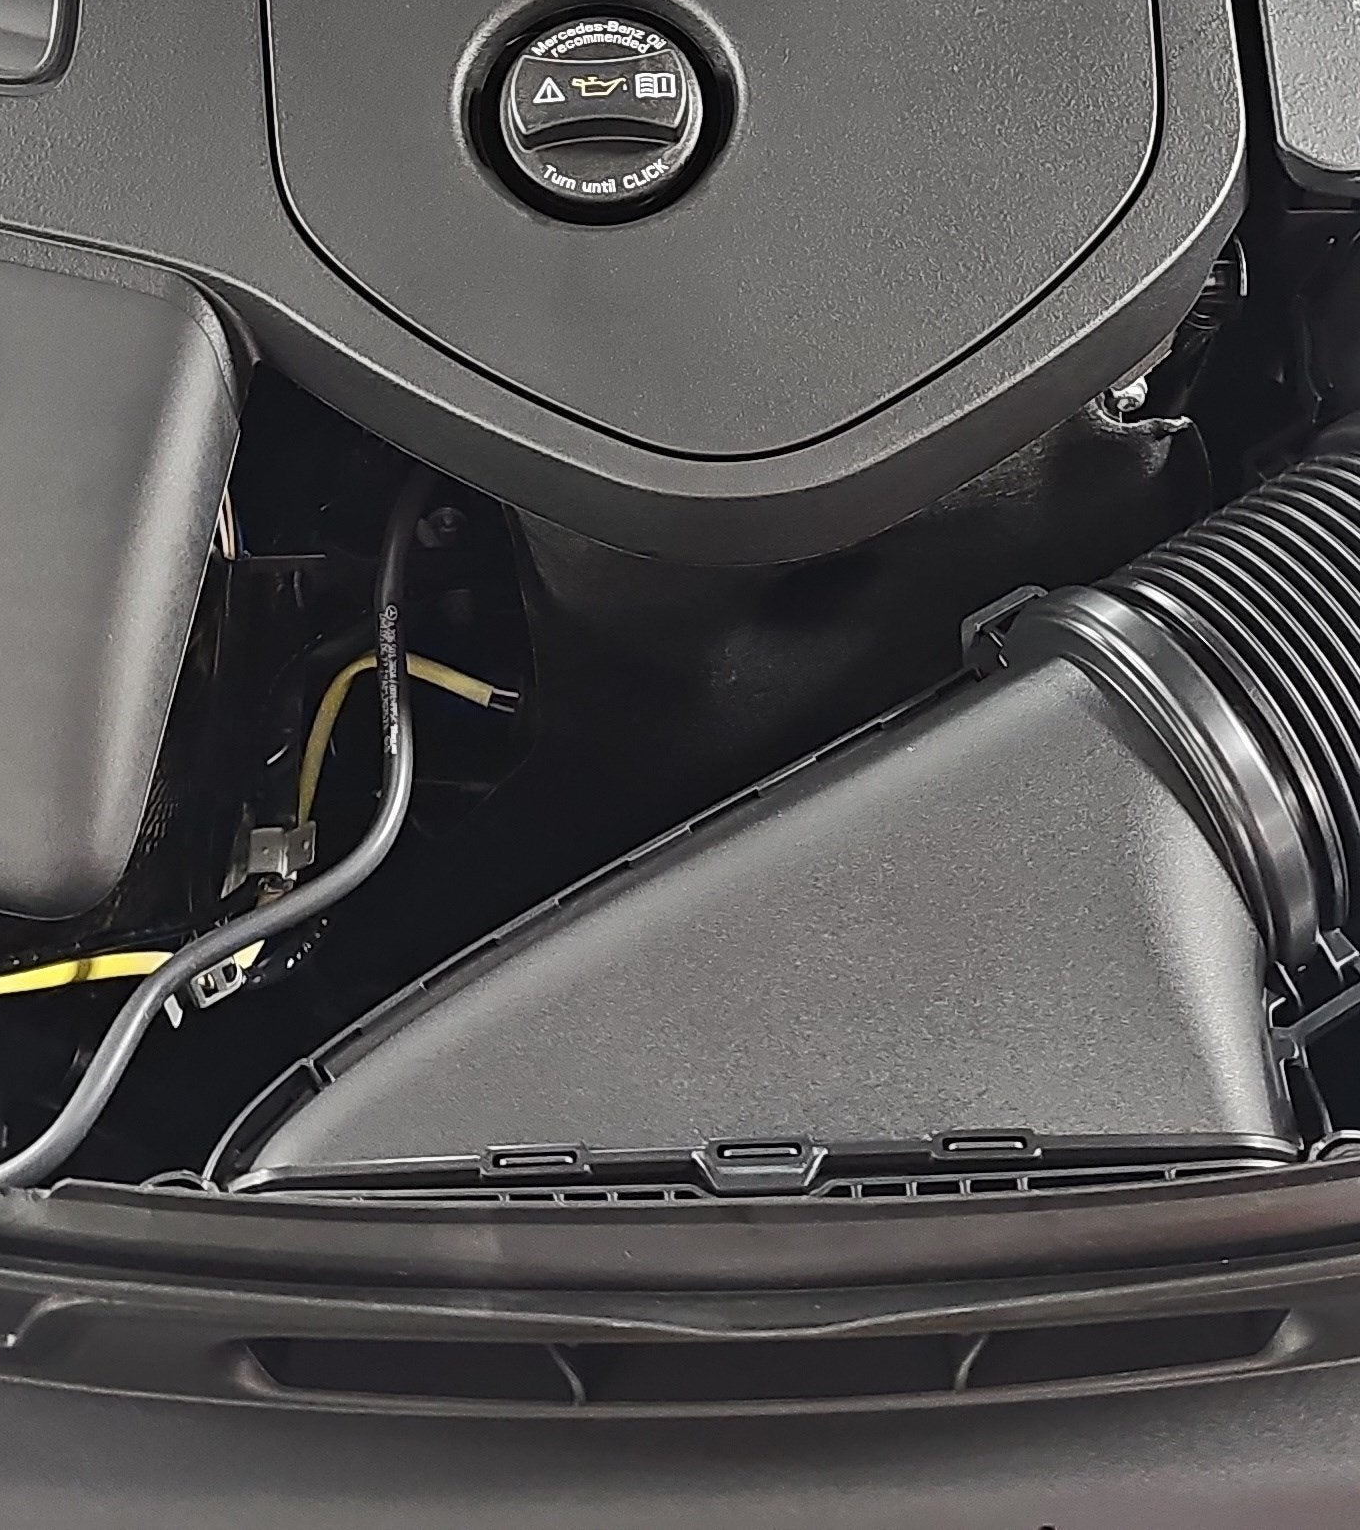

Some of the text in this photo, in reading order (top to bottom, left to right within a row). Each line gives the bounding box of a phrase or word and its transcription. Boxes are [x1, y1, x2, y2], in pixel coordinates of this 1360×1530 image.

[530, 20, 668, 56] Mercedes-Benz Oil
[550, 33, 651, 58] recommended
[542, 160, 670, 194] Turn until CLICK
